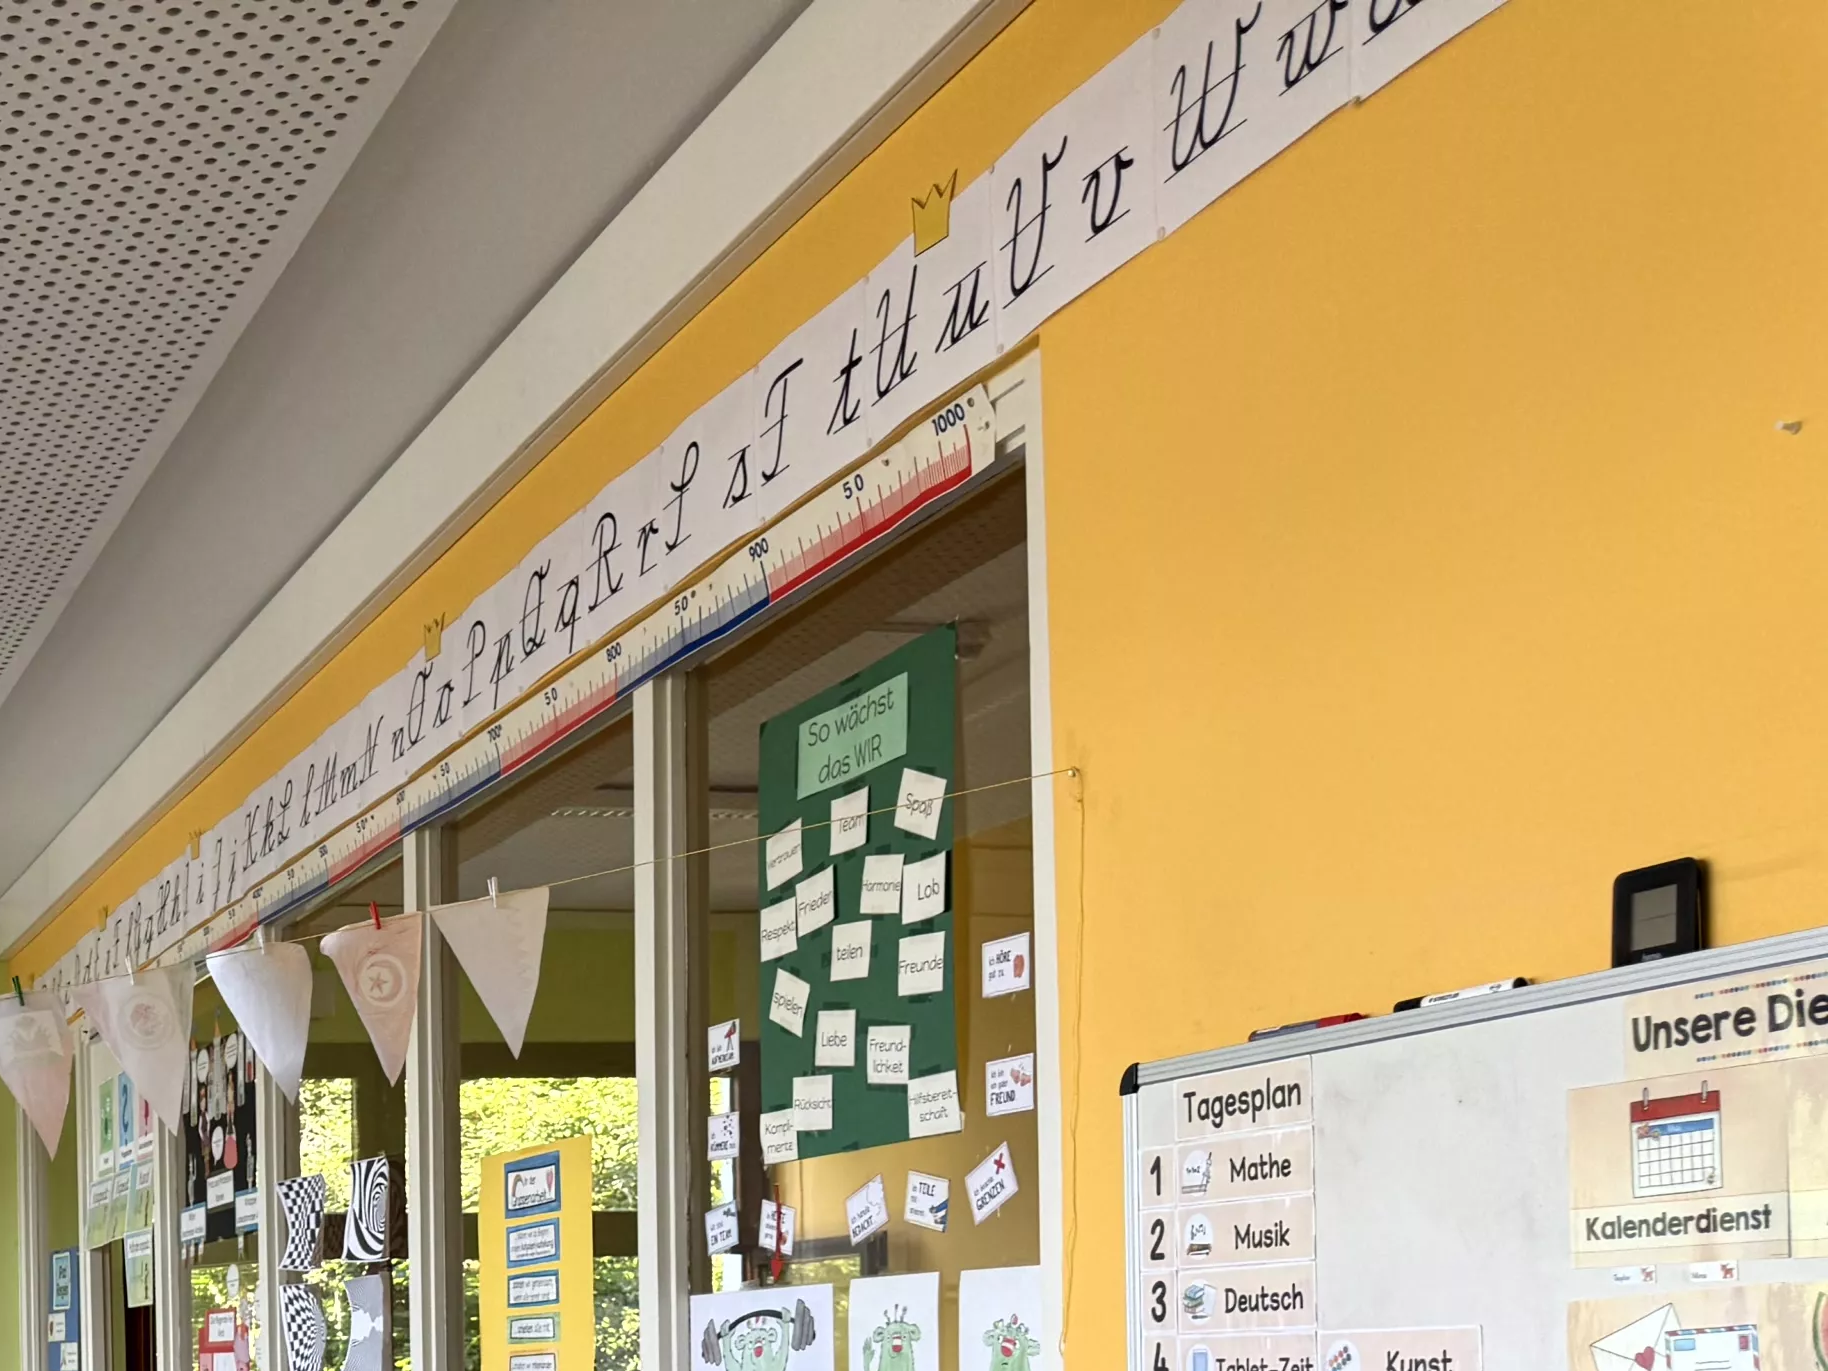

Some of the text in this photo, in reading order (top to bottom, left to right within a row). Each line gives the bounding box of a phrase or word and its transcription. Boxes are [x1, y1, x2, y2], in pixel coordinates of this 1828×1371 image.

[544, 688, 558, 706] 50
[606, 642, 622, 662] 800
[674, 596, 688, 615] 50
[749, 538, 769, 561] 900
[843, 474, 864, 499] 50
[931, 403, 966, 436] 1000
[808, 688, 894, 747] So wächst
[819, 733, 882, 784] das WIR
[905, 793, 934, 817] Spaß
[837, 814, 865, 834] Team
[862, 879, 901, 894] Harmonie
[917, 879, 940, 901] Lob
[798, 890, 833, 914] Frieden
[761, 919, 796, 941] Respekt
[836, 943, 863, 961] teilen
[996, 950, 1011, 963] HÖRE
[898, 955, 944, 975] Freunde
[1632, 988, 1828, 1052] Unsere Die
[821, 1031, 847, 1047] Liebe
[870, 1038, 907, 1053] Freund-
[794, 1096, 831, 1110] Rücksicht
[991, 1090, 1016, 1105] FREUND
[1183, 1080, 1301, 1123] Tagesplan
[1150, 1155, 1291, 1196] 1 Mathe
[1586, 1204, 1772, 1241] Kalenderdienst
[1150, 1218, 1290, 1262] 2 Musik
[1151, 1280, 1304, 1323] 3 Deutsch
